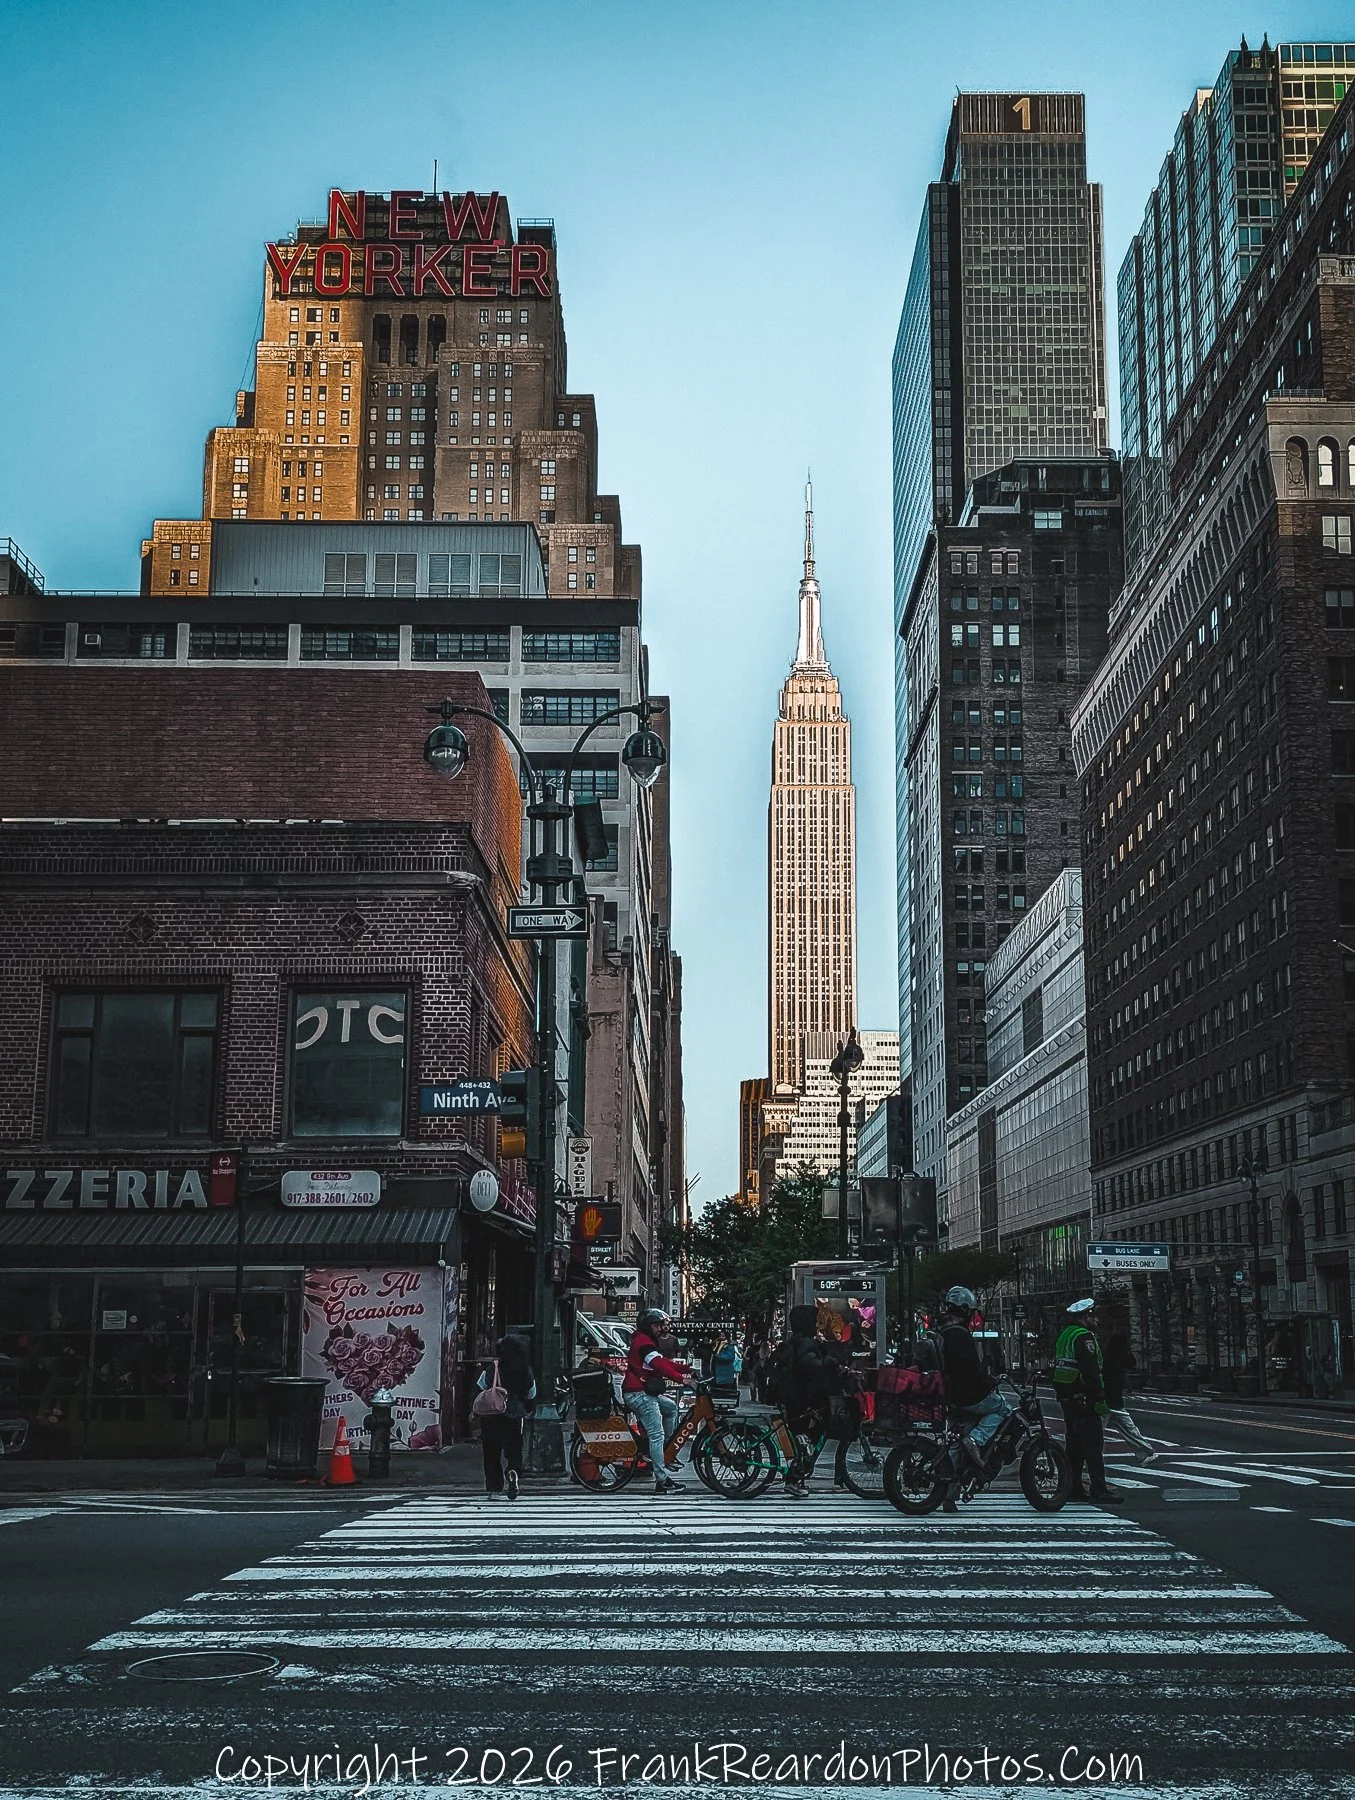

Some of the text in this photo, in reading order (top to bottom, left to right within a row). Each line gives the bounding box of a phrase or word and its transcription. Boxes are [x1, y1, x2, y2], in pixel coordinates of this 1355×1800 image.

[1012, 97, 1031, 130] 1
[328, 188, 500, 241] NEW
[265, 242, 552, 297] YORKER
[522, 915, 576, 926] ONE WAY
[433, 1092, 517, 1108] Ninth Ave
[5, 1170, 208, 1208] ZZERIA
[1116, 1260, 1138, 1268] BUSES
[327, 1271, 421, 1301] For All
[323, 1300, 425, 1326] Occasions
[323, 1408, 341, 1418] DAY
[396, 1410, 415, 1421] DAY
[595, 1433, 621, 1441] JOCO
[674, 1422, 694, 1450] JOCO
